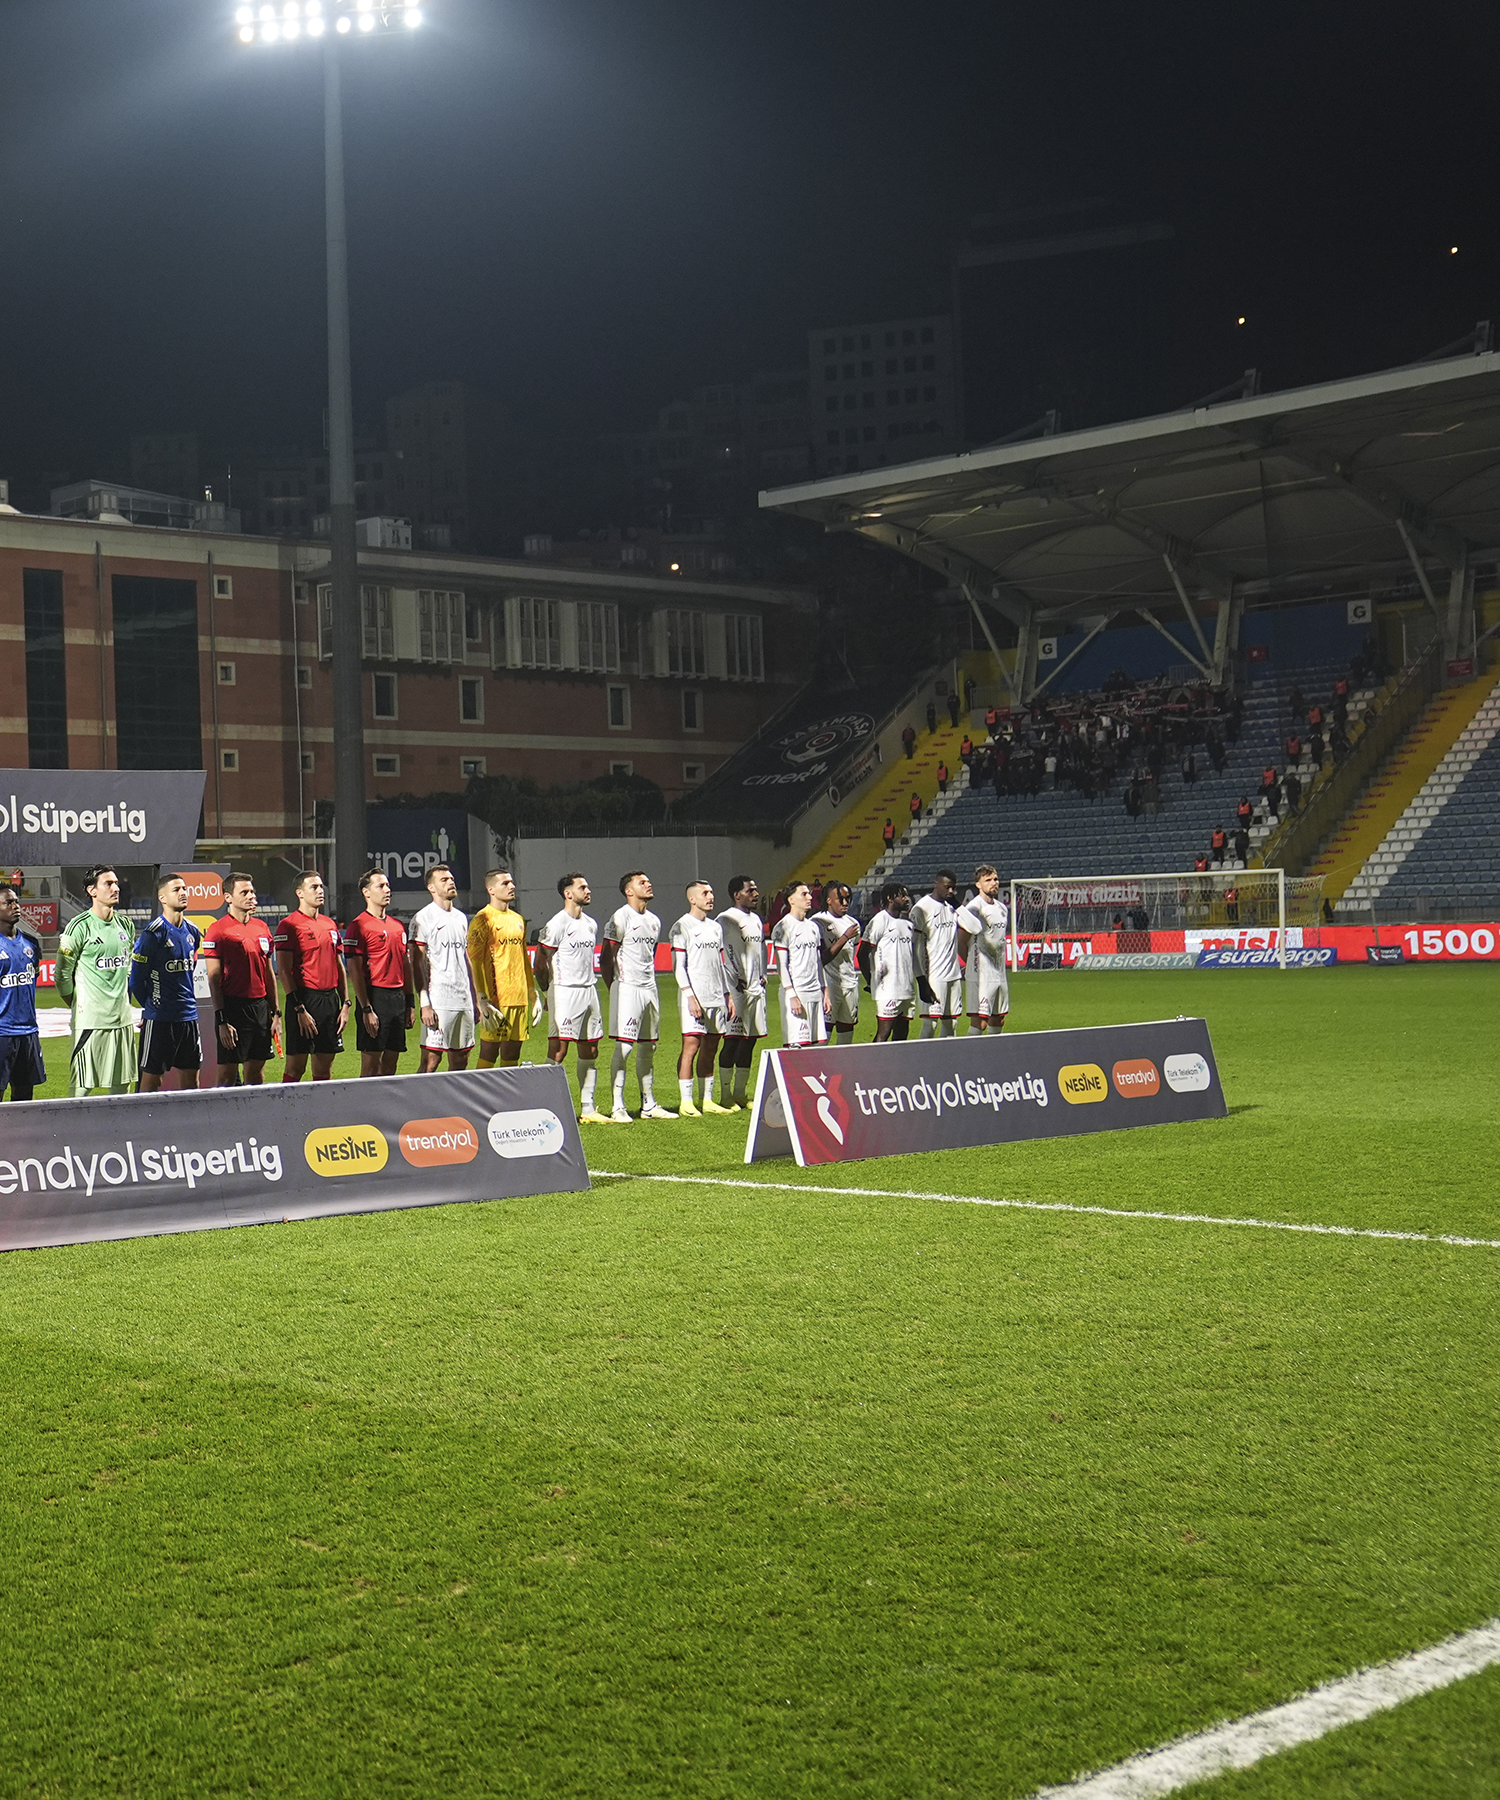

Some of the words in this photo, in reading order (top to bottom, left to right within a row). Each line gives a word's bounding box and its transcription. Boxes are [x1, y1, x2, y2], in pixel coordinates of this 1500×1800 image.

[1353, 605, 1366, 618] G
[1042, 643, 1053, 655] G
[23, 801, 147, 843] süperLig
[1404, 929, 1495, 955] 1500
[1116, 1068, 1156, 1086] trendyol
[855, 1074, 967, 1116] trendyol
[967, 1072, 1049, 1111] süperLig
[406, 1128, 471, 1150] trendyol
[492, 1130, 510, 1140] Türk
[512, 1128, 545, 1138] Telekom
[143, 1137, 283, 1189] süperLig
